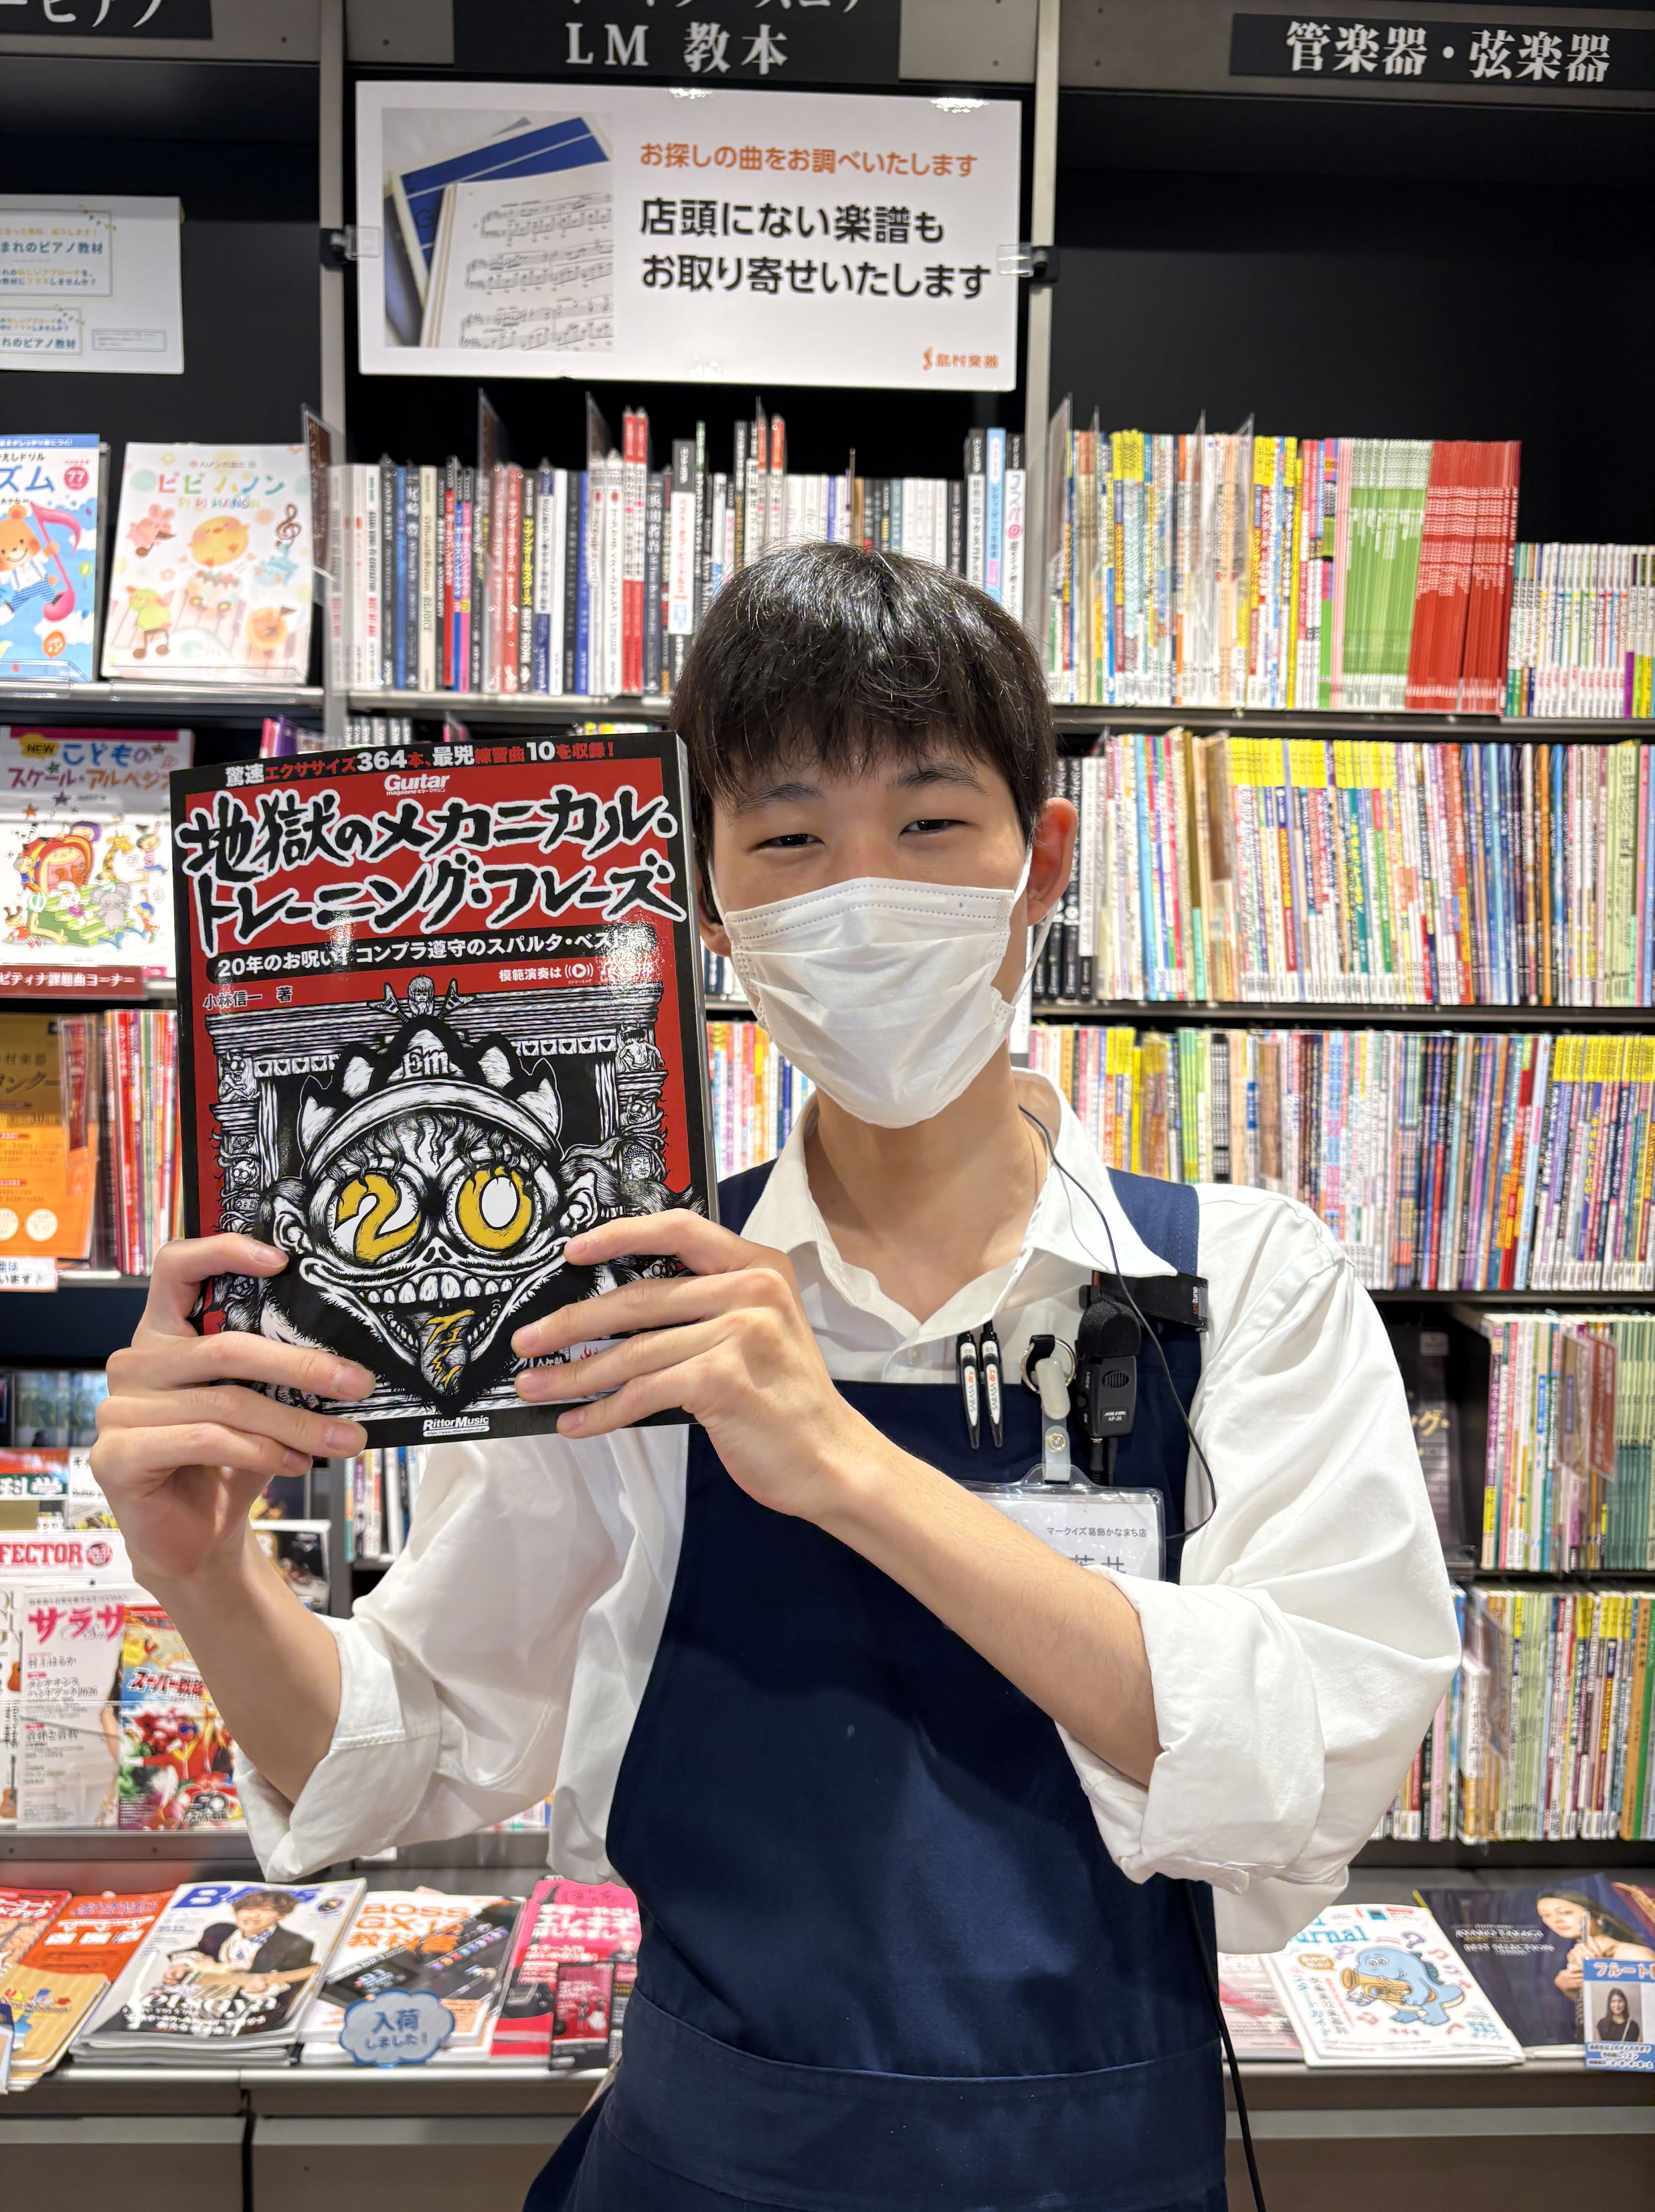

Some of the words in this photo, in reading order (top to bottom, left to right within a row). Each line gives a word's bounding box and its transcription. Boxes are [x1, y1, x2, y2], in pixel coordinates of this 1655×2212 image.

[565, 22, 649, 66] LM
[683, 22, 788, 75] 教本
[1285, 21, 1610, 83] 管楽器・弦楽器
[639, 142, 978, 176] お探しの曲をお調べいたします
[639, 198, 944, 245] 店頭にない楽譜も
[642, 255, 990, 299] お取り寄せいたします
[936, 353, 999, 370] 島村楽器
[27, 743, 55, 753] NEW
[63, 742, 152, 767] こどもの
[384, 774, 451, 791] Guitar
[499, 966, 562, 982] 模範演奏は
[203, 990, 262, 1010] 小林信一
[275, 985, 293, 1004] 著
[0, 1053, 47, 1066] 村楽器
[990, 1382, 999, 1411] SARASA
[423, 1415, 489, 1431] RittorMusic
[1046, 1527, 1147, 1537] マークイズ葛飾かなまち店
[174, 1886, 322, 1908] BS
[362, 1903, 470, 1918] BOSS
[1293, 1925, 1371, 1944] urnal
[371, 2008, 419, 2034] 入荷
[364, 2031, 428, 2049] しました！
